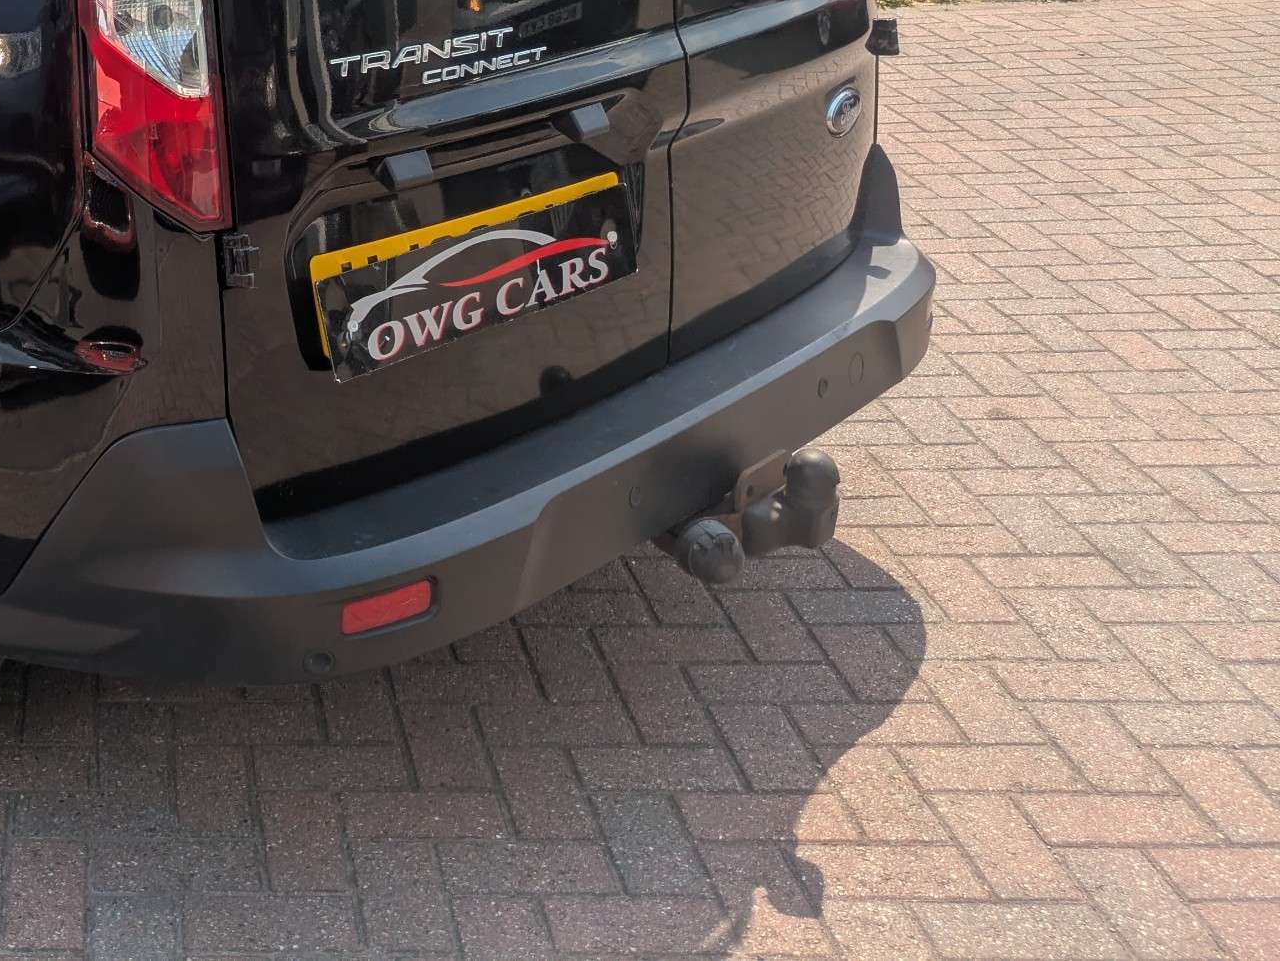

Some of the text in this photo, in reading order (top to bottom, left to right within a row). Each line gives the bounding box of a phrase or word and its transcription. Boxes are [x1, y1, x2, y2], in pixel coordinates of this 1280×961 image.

[330, 27, 514, 77] TRANSIT
[422, 46, 547, 85] CONNECT
[367, 246, 610, 363] OWG CARS
